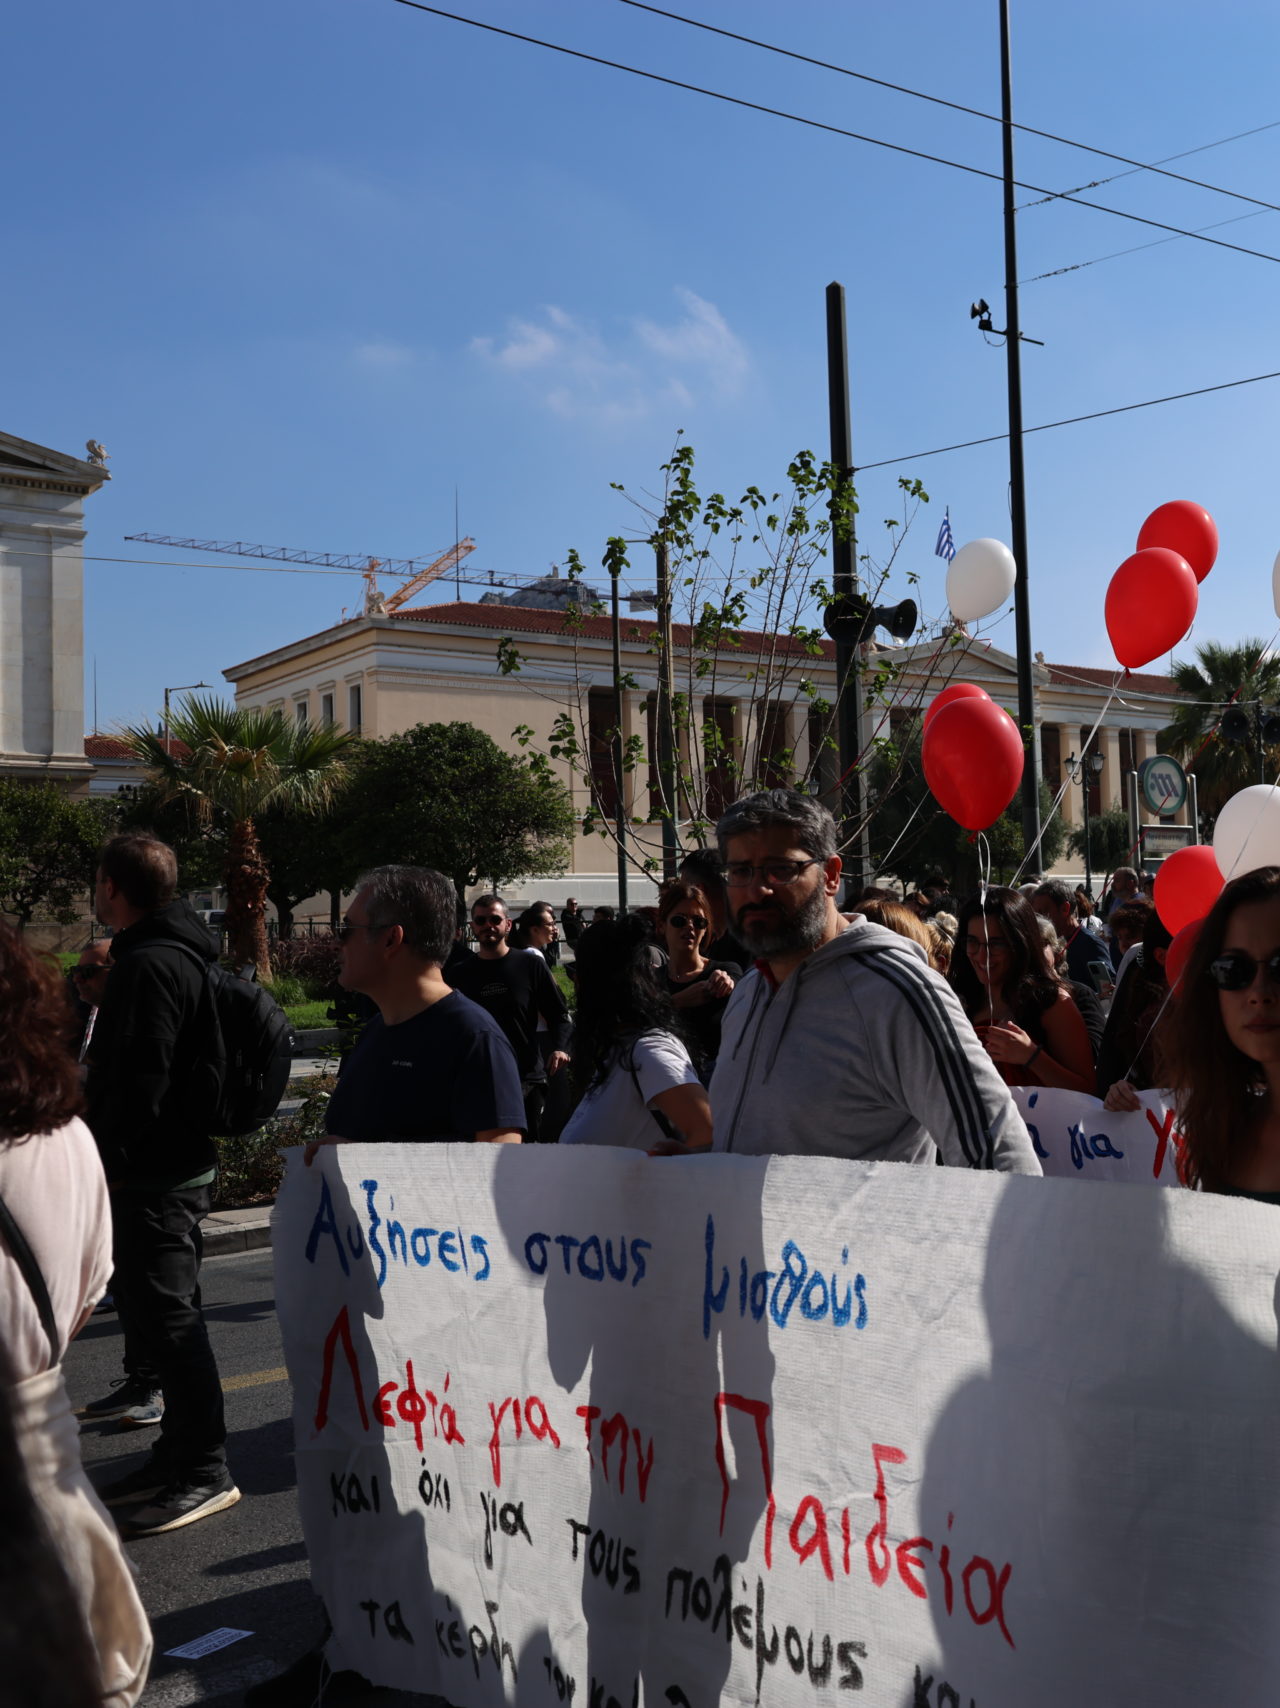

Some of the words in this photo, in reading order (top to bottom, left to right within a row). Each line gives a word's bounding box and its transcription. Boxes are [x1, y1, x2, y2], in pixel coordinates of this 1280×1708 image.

[1068, 1123, 1122, 1169] για
[306, 1172, 490, 1289] Αυξήσεις
[525, 1232, 652, 1287] στους
[702, 1213, 869, 1340] μισθούς
[310, 1304, 465, 1452] Λεφτά
[488, 1396, 560, 1488] για
[576, 1406, 654, 1503] την
[714, 1391, 1016, 1649] Παιδεία
[331, 1472, 380, 1518] και
[418, 1457, 450, 1513] όχι
[480, 1491, 533, 1570] για
[566, 1519, 640, 1594] τους
[665, 1553, 868, 1706] πολέμους
[360, 1598, 415, 1646] τα
[434, 1594, 518, 1686] κέρδη
